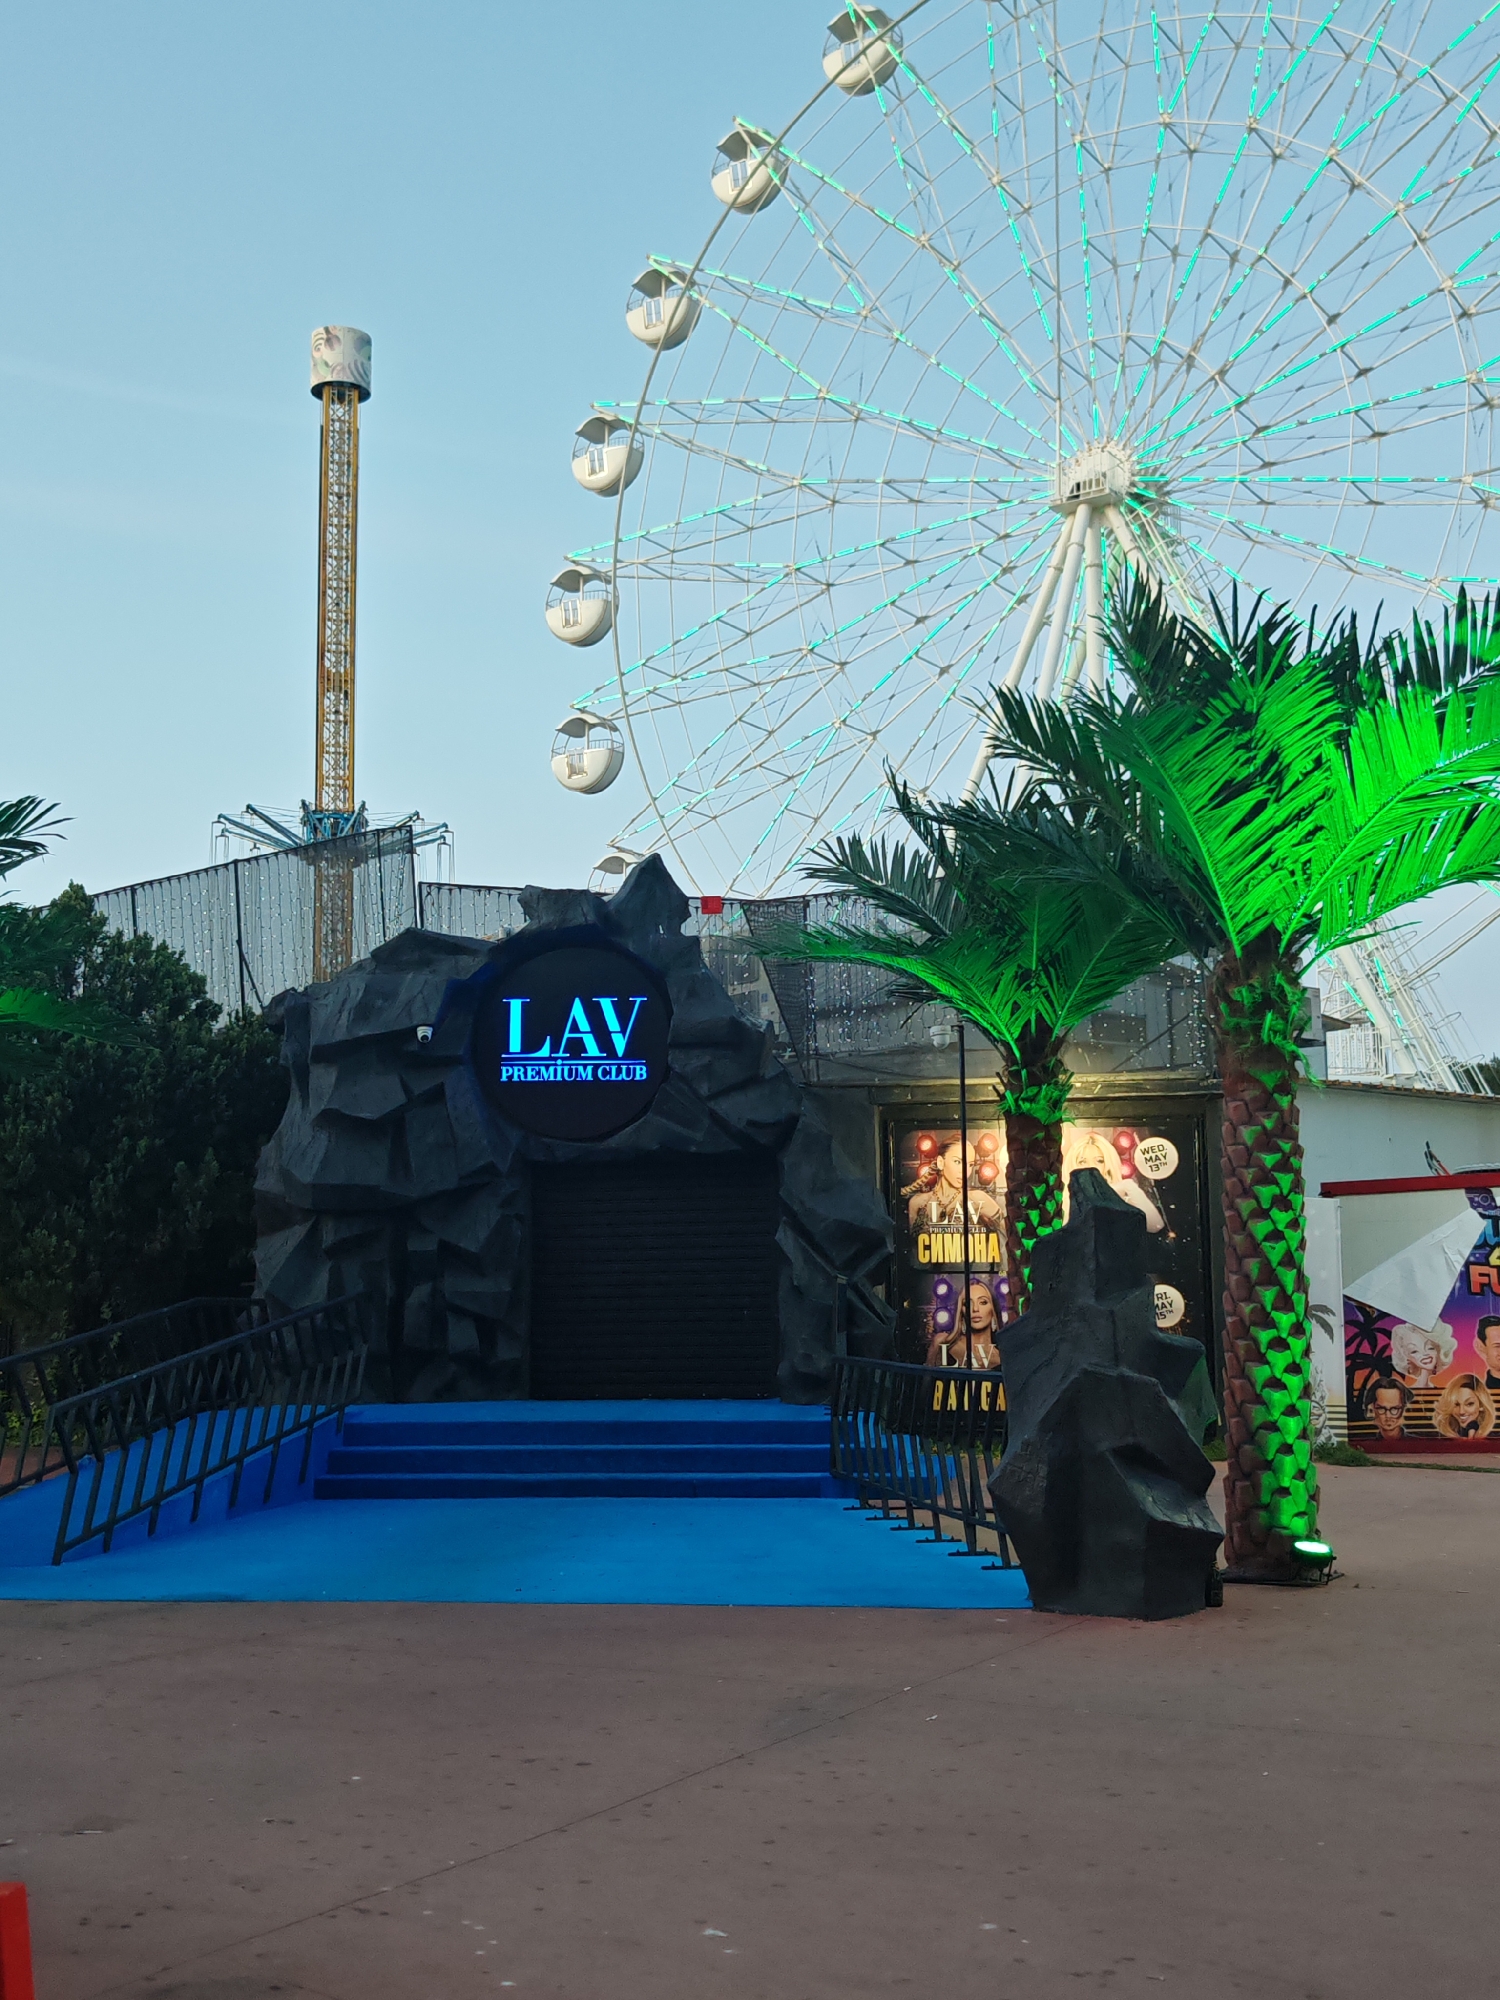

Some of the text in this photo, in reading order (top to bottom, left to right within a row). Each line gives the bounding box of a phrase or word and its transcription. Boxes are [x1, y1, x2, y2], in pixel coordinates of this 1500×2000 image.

[501, 997, 647, 1058] LAV
[597, 1065, 647, 1081] CLUB
[1140, 1144, 1168, 1156] WED.
[1144, 1152, 1168, 1165] MAY
[1148, 1162, 1168, 1173] 13TH
[928, 1201, 985, 1225] LAV
[938, 1343, 997, 1369] LAV
